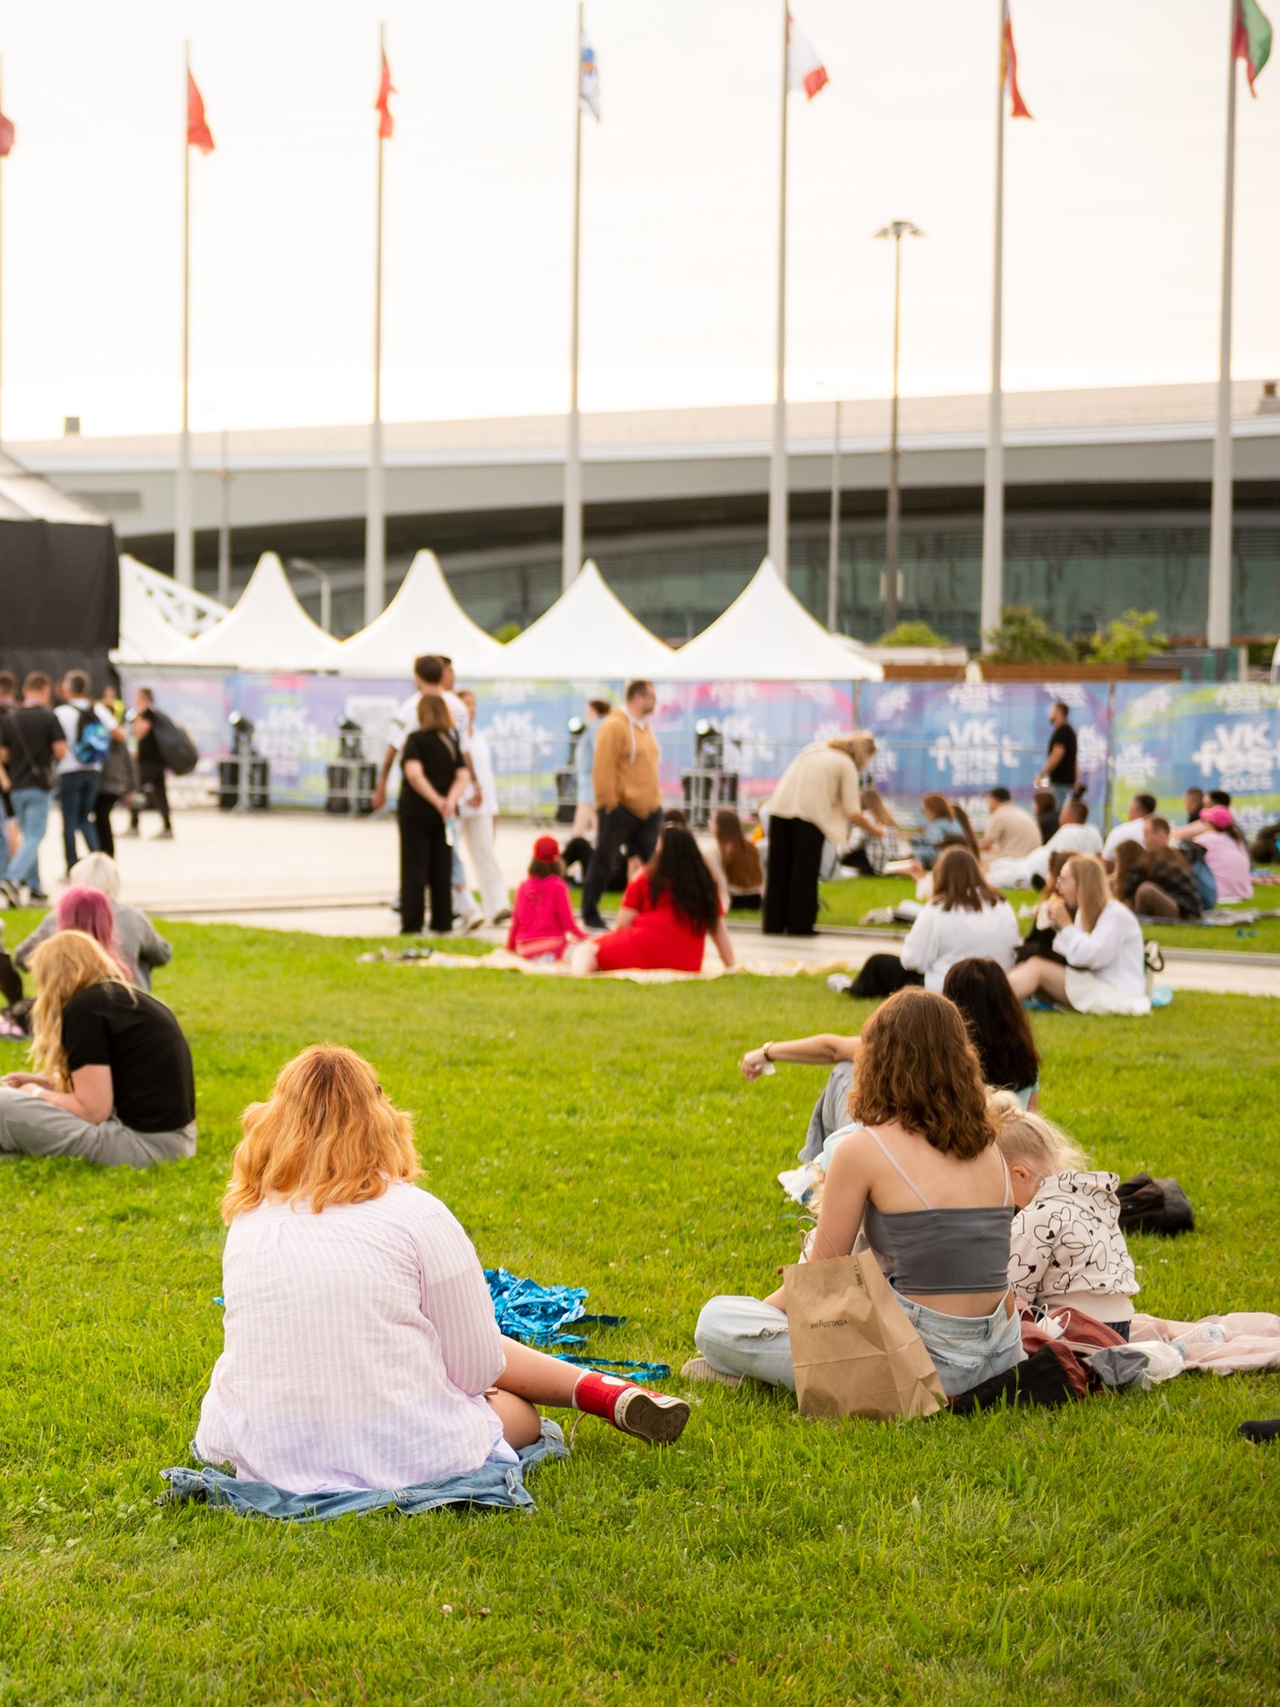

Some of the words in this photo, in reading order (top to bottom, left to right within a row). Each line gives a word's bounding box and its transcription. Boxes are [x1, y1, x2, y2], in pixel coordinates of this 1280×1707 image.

[947, 717, 999, 746] VK
[1214, 722, 1272, 748] VK
[928, 735, 1023, 772] fest
